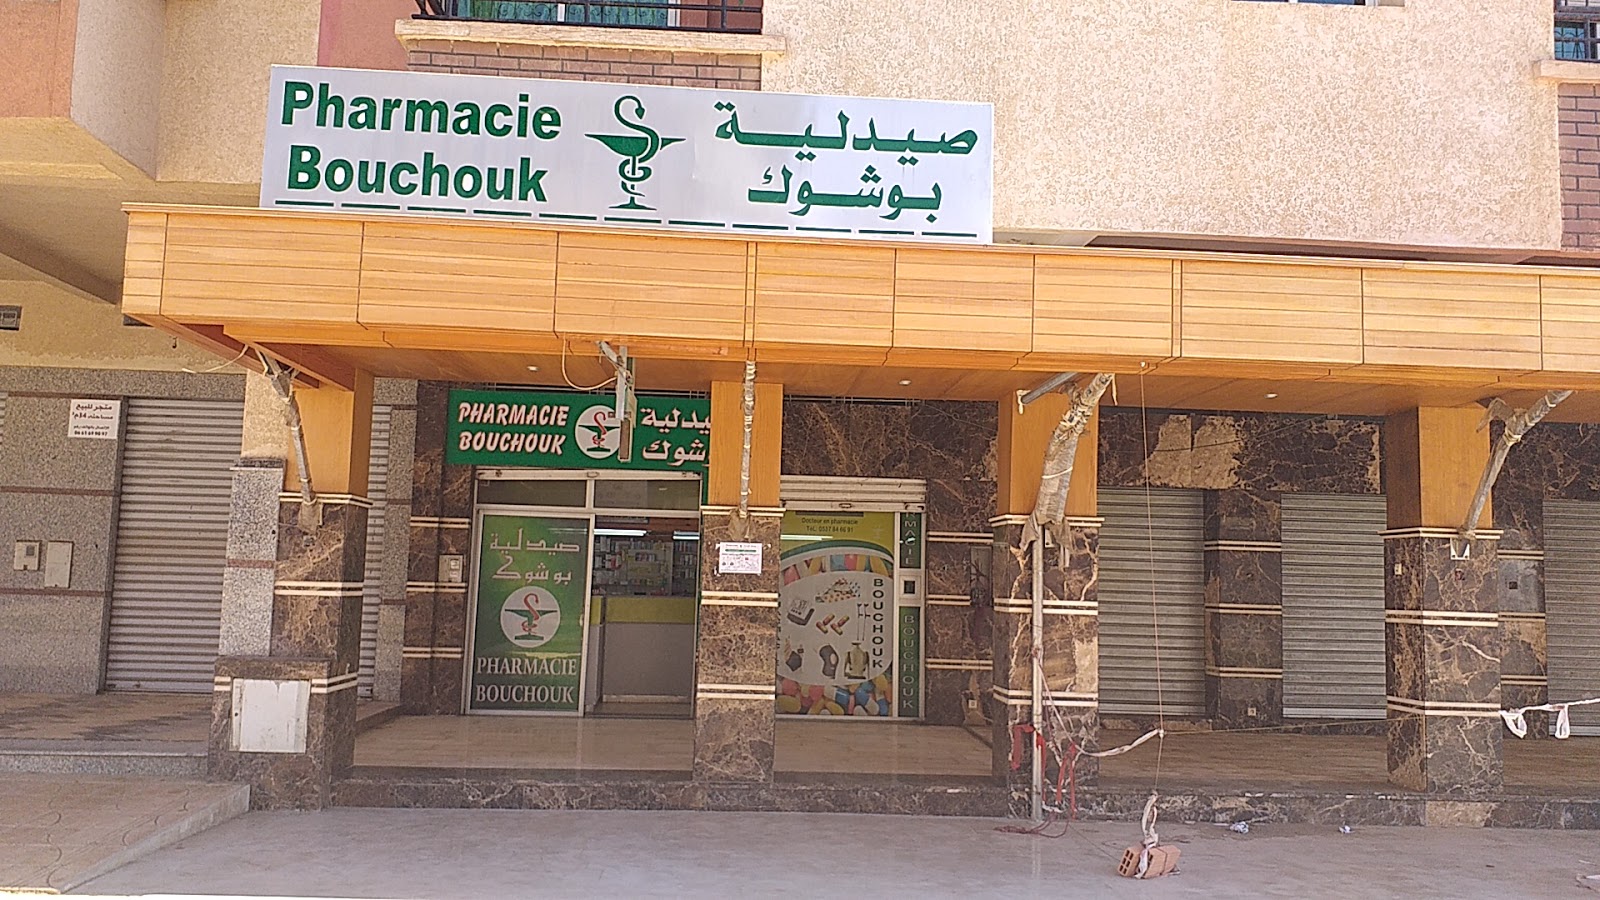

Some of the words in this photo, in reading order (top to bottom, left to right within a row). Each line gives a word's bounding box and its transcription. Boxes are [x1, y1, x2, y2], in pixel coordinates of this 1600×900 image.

[281, 81, 562, 139] Pharmacie
[714, 100, 979, 167] صيدلية
[287, 145, 549, 203] Bouchouk
[747, 163, 943, 223] بوشوك
[458, 402, 570, 427] PHARMACIE
[640, 407, 711, 434] يدلية
[459, 431, 566, 456] BOUCHOUK
[642, 439, 710, 467] شوك
[830, 518, 858, 526] pharmacie
[489, 528, 580, 556] صيدلية
[492, 555, 572, 585] بوشوك
[872, 578, 884, 669] BOUCHOUK
[477, 657, 577, 676] PHARMACIE
[903, 615, 915, 709] BOUCHOUK
[476, 684, 574, 703] BOUCHOUK
